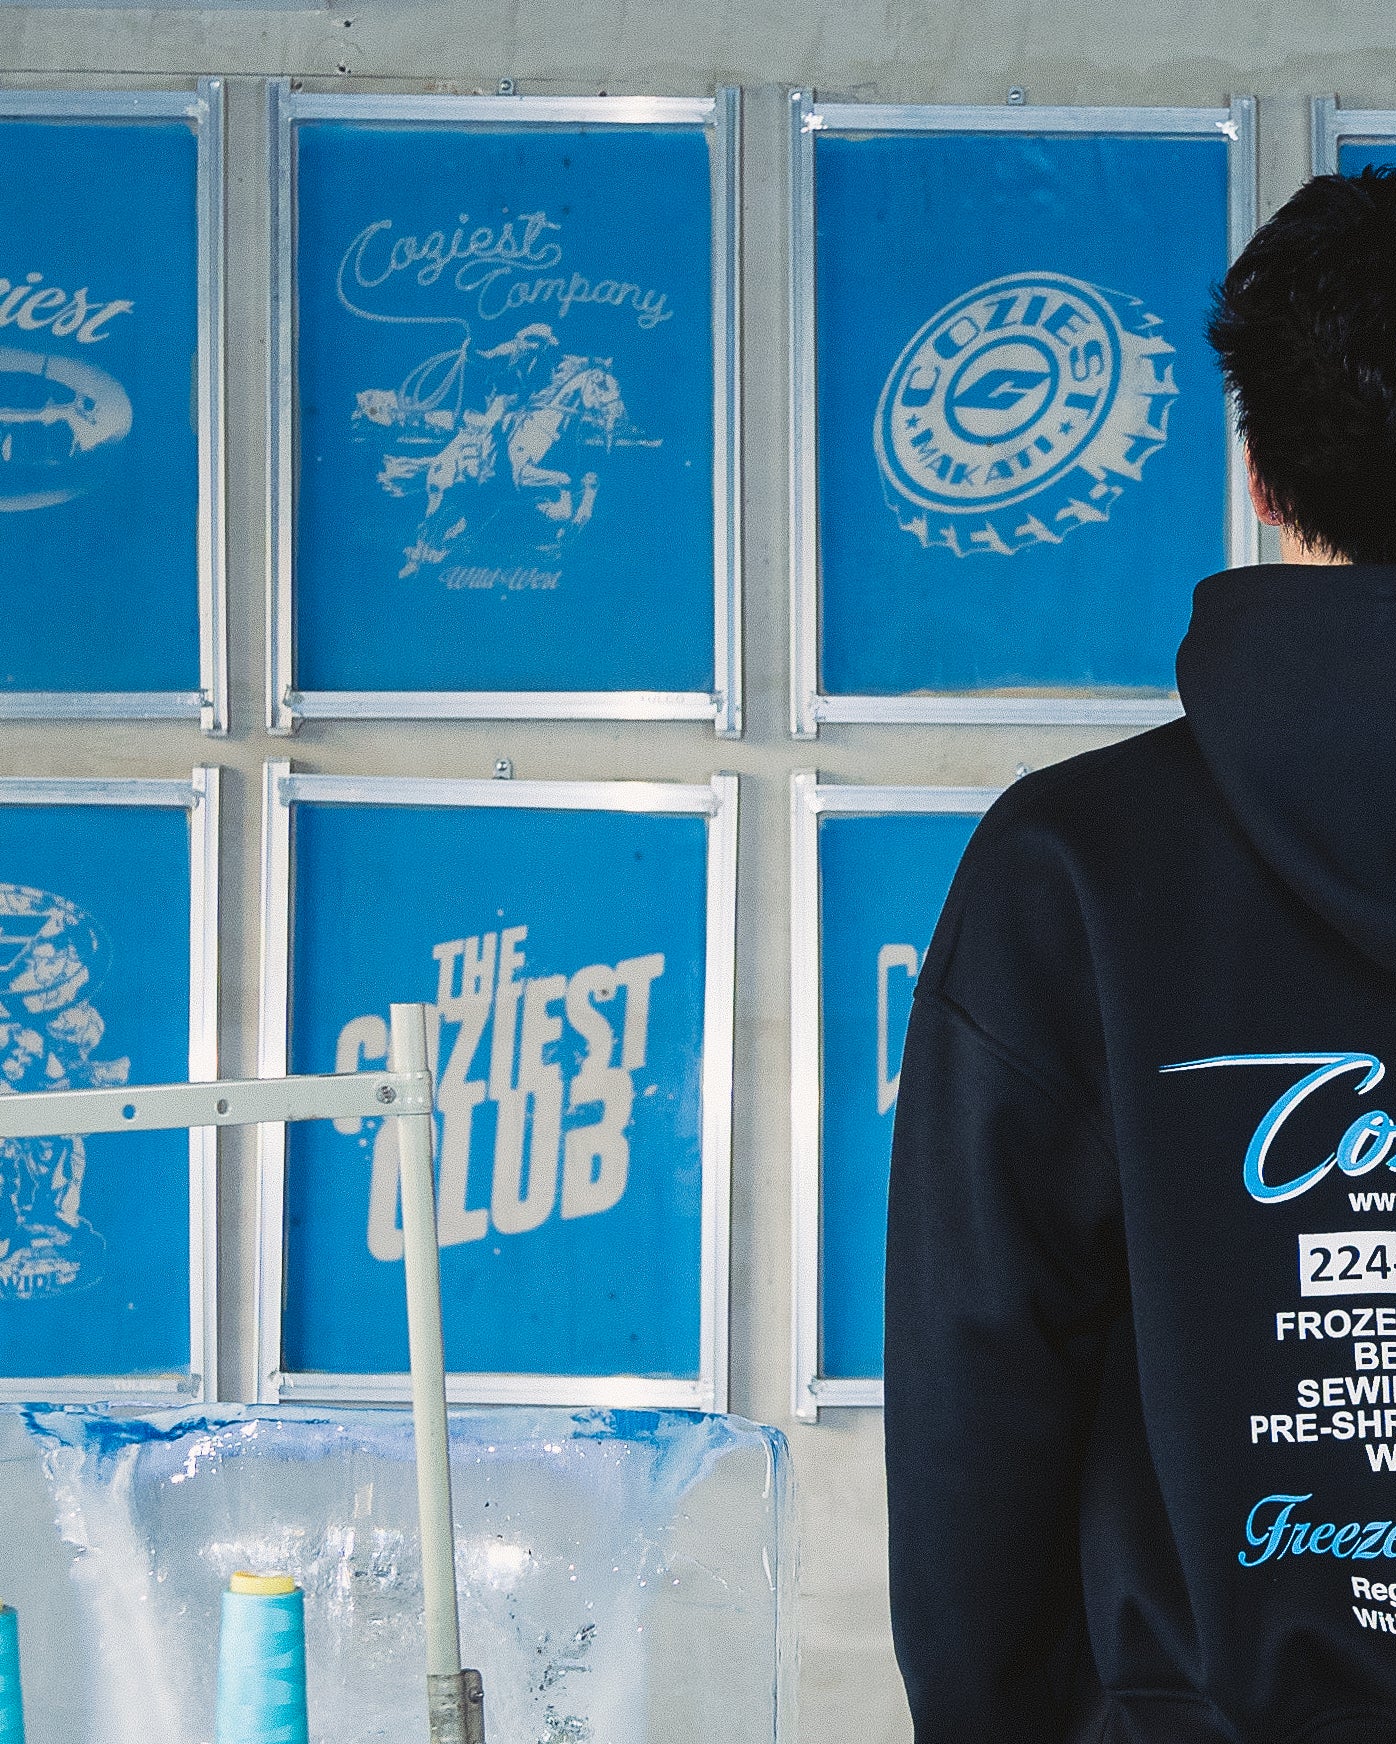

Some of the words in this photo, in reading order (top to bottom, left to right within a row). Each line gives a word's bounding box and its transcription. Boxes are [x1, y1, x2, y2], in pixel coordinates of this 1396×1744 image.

[462, 266, 673, 329] Company
[901, 294, 1105, 420] COZIEST
[910, 426, 1054, 485] MAKATI
[433, 925, 528, 1000] THE
